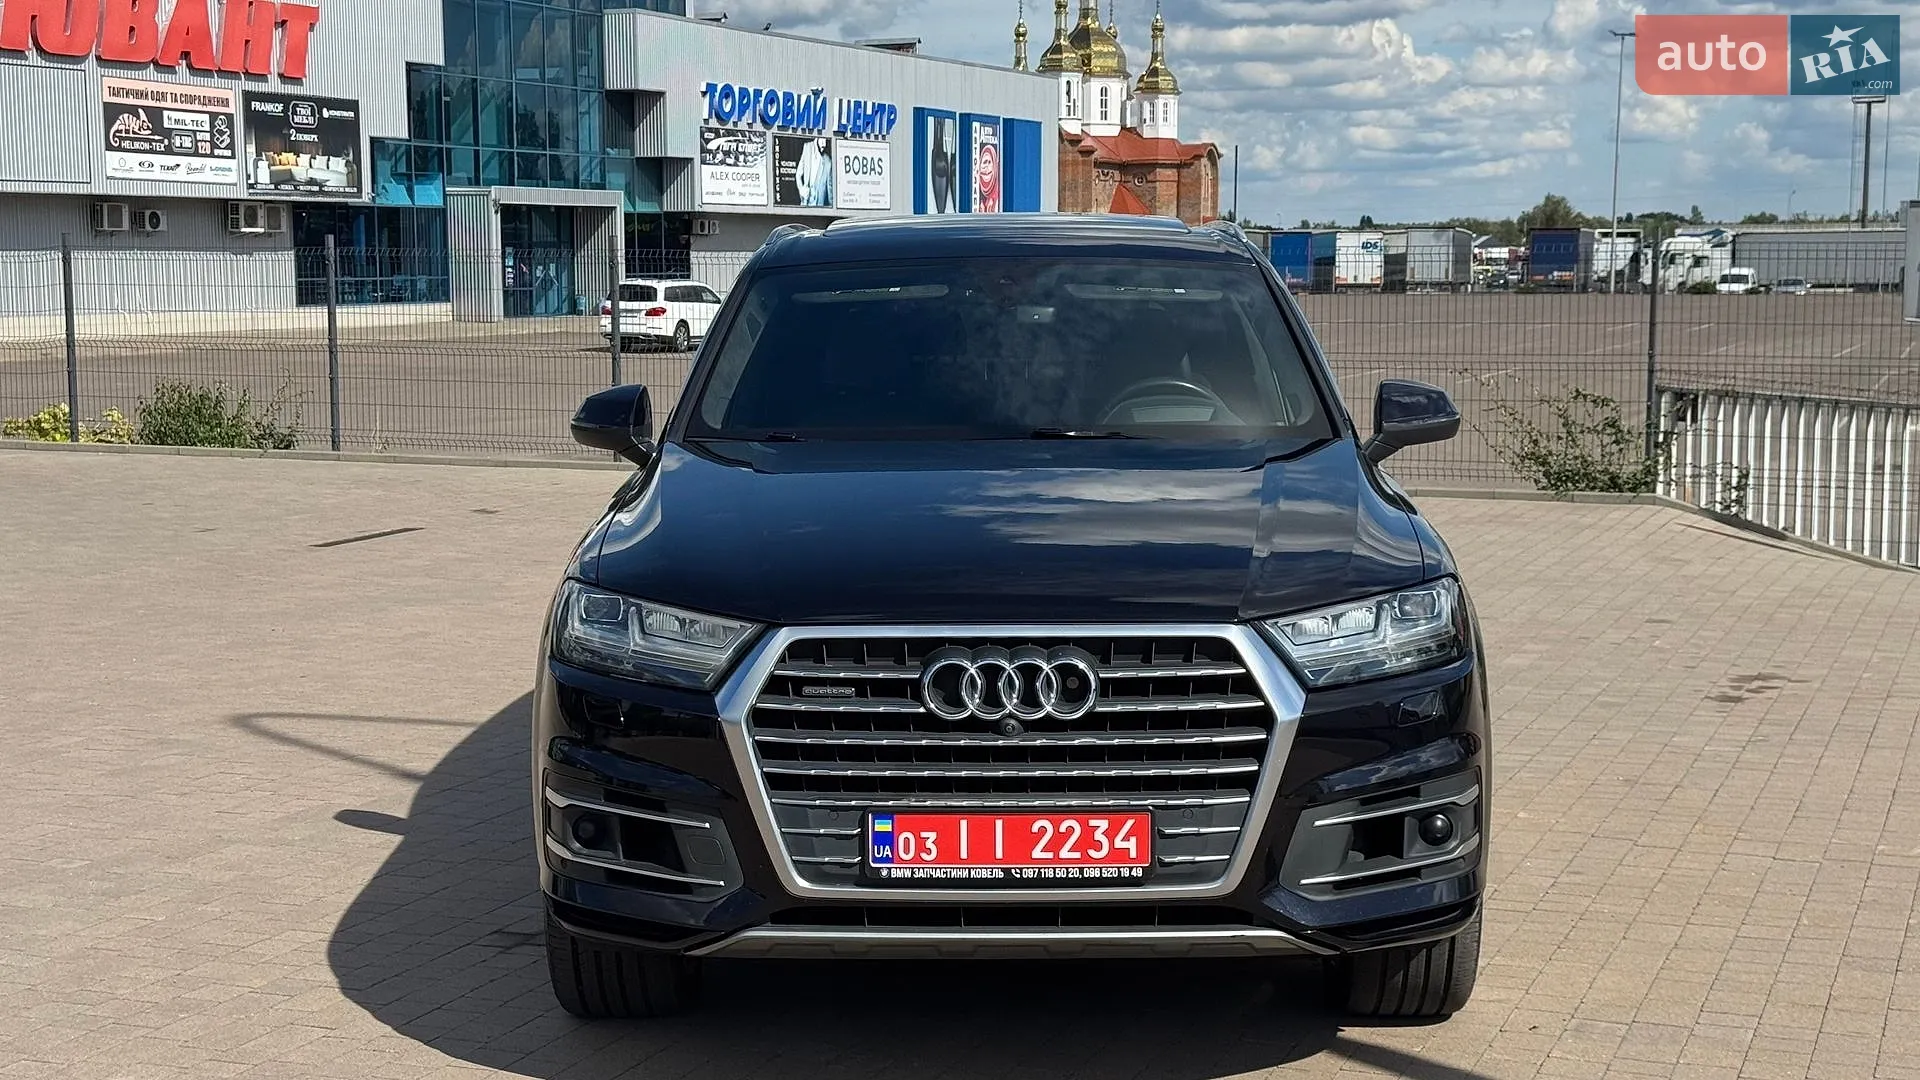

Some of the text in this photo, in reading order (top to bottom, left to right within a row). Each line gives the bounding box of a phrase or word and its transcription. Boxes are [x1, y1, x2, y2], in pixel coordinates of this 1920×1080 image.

[107, 86, 150, 101] ТАКТИЧНИЙ
[150, 90, 169, 103] ОДЯГ
[170, 92, 179, 103] ТА
[251, 101, 284, 112] FRANKOF
[701, 82, 898, 137] ТОРГОВИЙ ЦЕНТР
[290, 128, 297, 141] 2
[197, 141, 211, 154] 120
[844, 155, 884, 176] BOBAS
[710, 171, 760, 182] ALEX COOPER
[1361, 241, 1379, 250] IDS
[897, 831, 938, 861] 03
[1030, 819, 1137, 859] 2234
[874, 846, 892, 858] UA
[891, 868, 912, 878] BMW
[913, 868, 969, 878] ЗАПЧАСТИНИ
[970, 868, 1004, 878] КОВЕЛЬ
[1022, 868, 1038, 878] 097
[1039, 868, 1054, 878] 118
[1056, 868, 1067, 878] 50
[1102, 868, 1119, 878] 520
[1120, 868, 1130, 878] 19
[1131, 868, 1143, 878] 49
